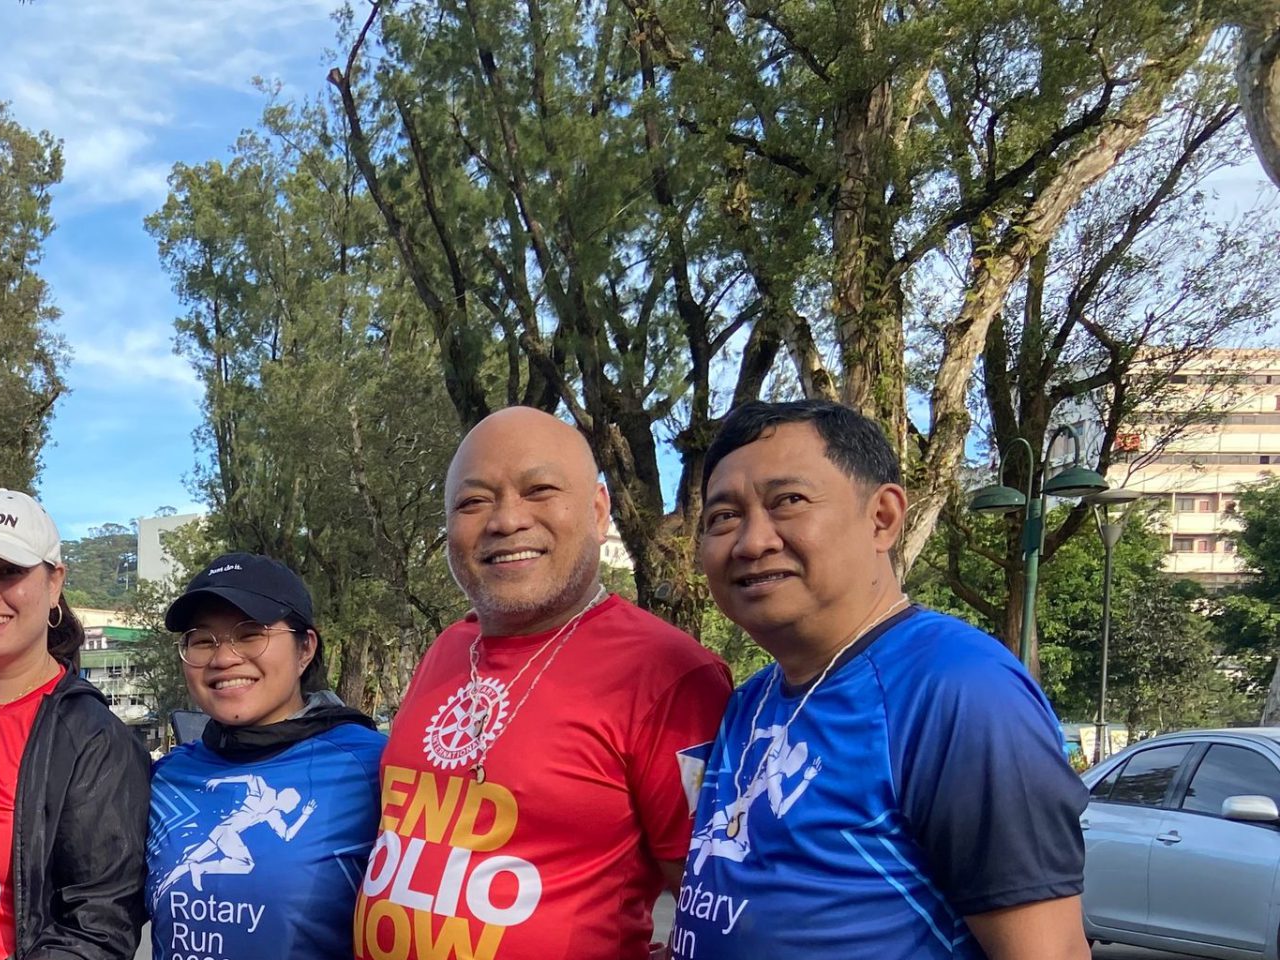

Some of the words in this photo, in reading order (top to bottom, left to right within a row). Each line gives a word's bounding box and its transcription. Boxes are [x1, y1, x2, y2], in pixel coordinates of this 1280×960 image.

[208, 567, 224, 576] Just
[379, 765, 519, 852] END
[362, 830, 543, 927] OLIO
[169, 890, 266, 934] Rotary
[677, 881, 750, 935] otary
[171, 921, 224, 955] Run
[671, 924, 696, 959] un
